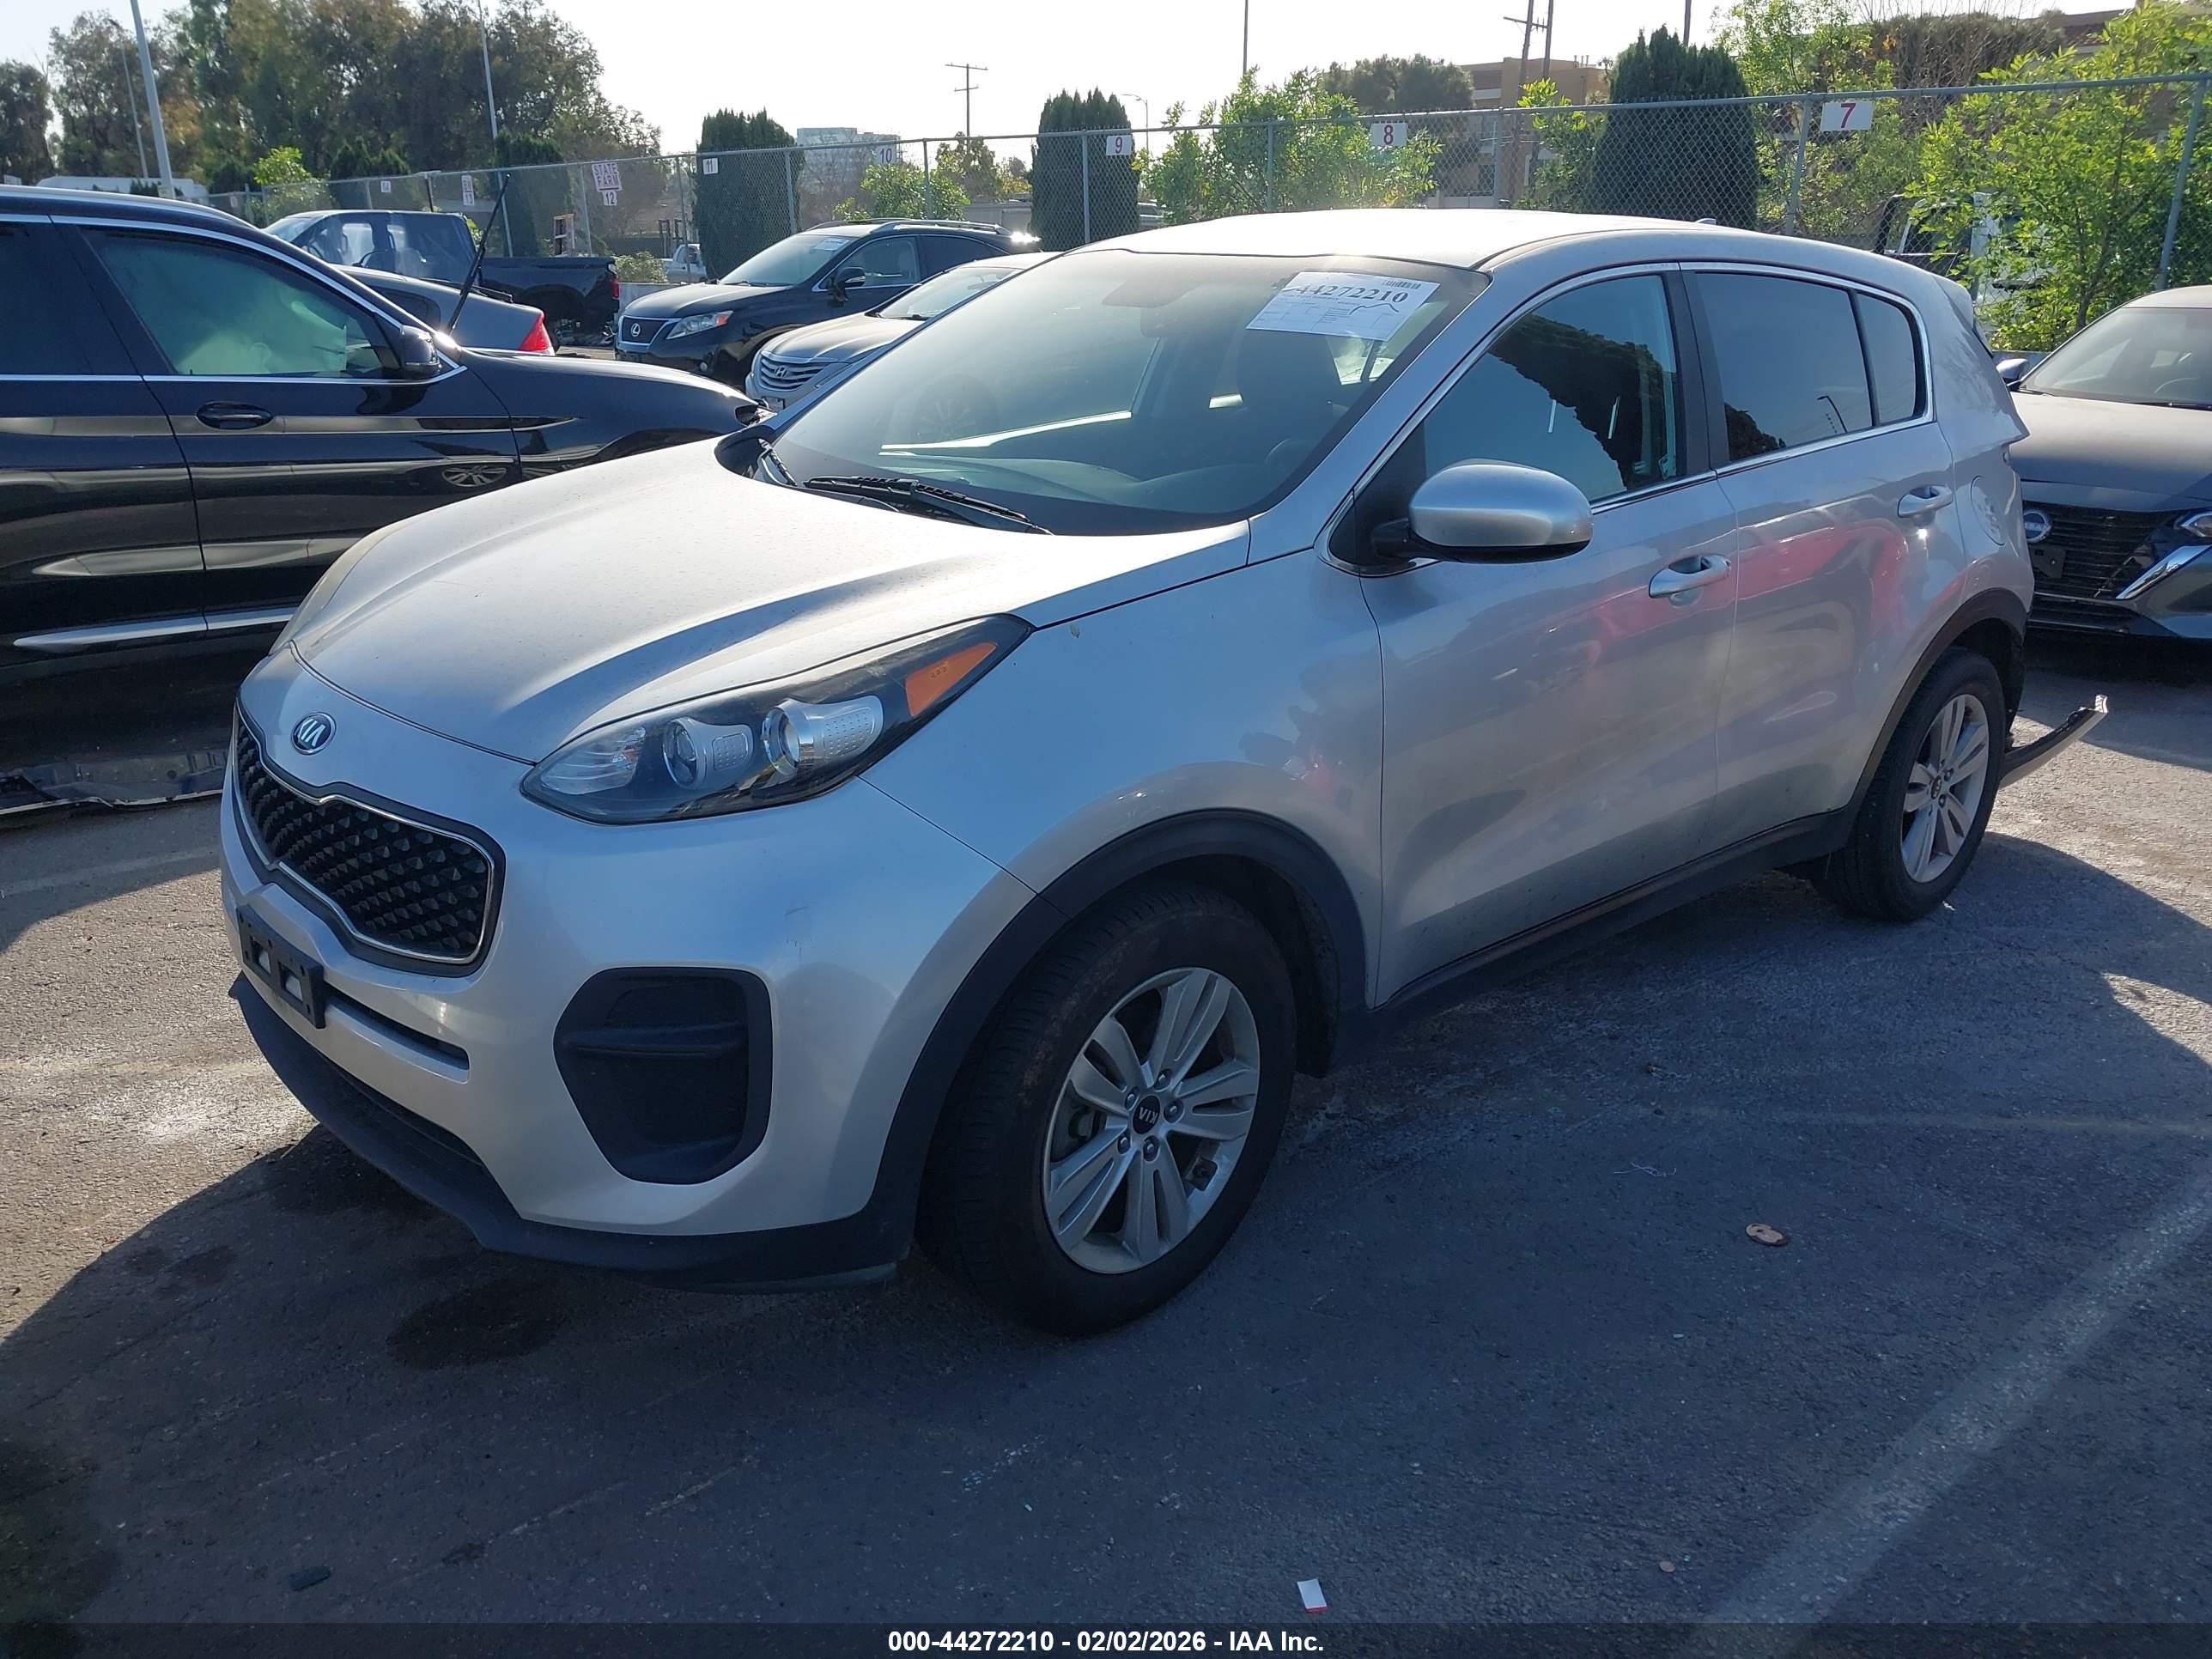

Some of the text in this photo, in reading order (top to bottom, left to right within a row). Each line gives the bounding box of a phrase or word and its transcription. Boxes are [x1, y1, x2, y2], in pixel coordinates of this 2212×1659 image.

[1840, 102, 1856, 129] 7
[1383, 125, 1394, 145] 8
[1115, 137, 1123, 154] 9
[879, 148, 892, 163] 10
[593, 163, 618, 176] STATE
[707, 159, 713, 173] 11
[597, 173, 619, 186] FARM
[605, 191, 615, 204] 12
[1296, 283, 1409, 303] 44272210
[297, 718, 326, 747] KIA
